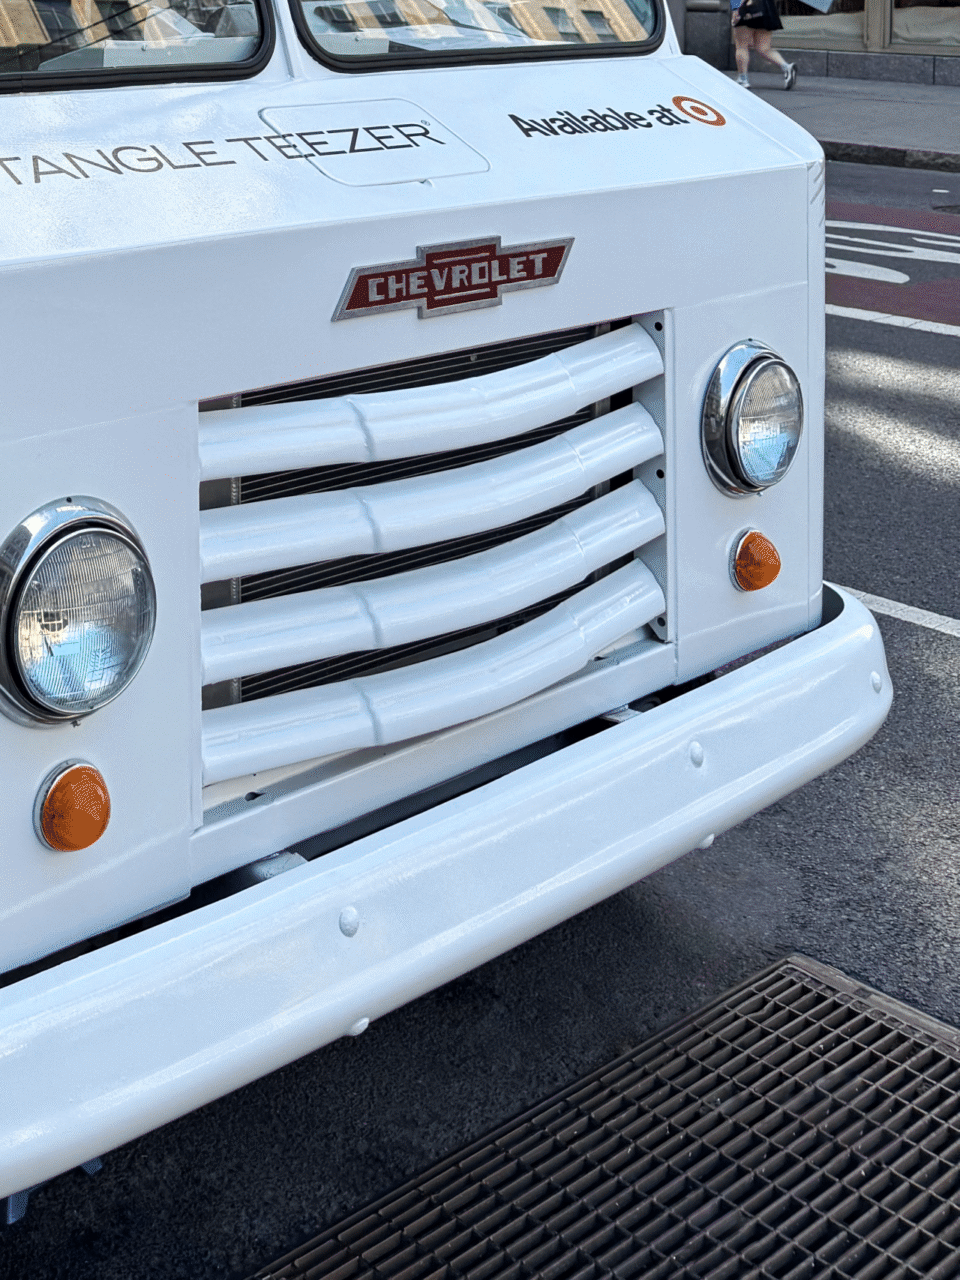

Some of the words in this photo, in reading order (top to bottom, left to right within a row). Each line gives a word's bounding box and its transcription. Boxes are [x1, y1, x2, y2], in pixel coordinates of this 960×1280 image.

[508, 107, 652, 138] Available
[647, 103, 691, 127] at
[367, 252, 549, 302] CHEVROLET
